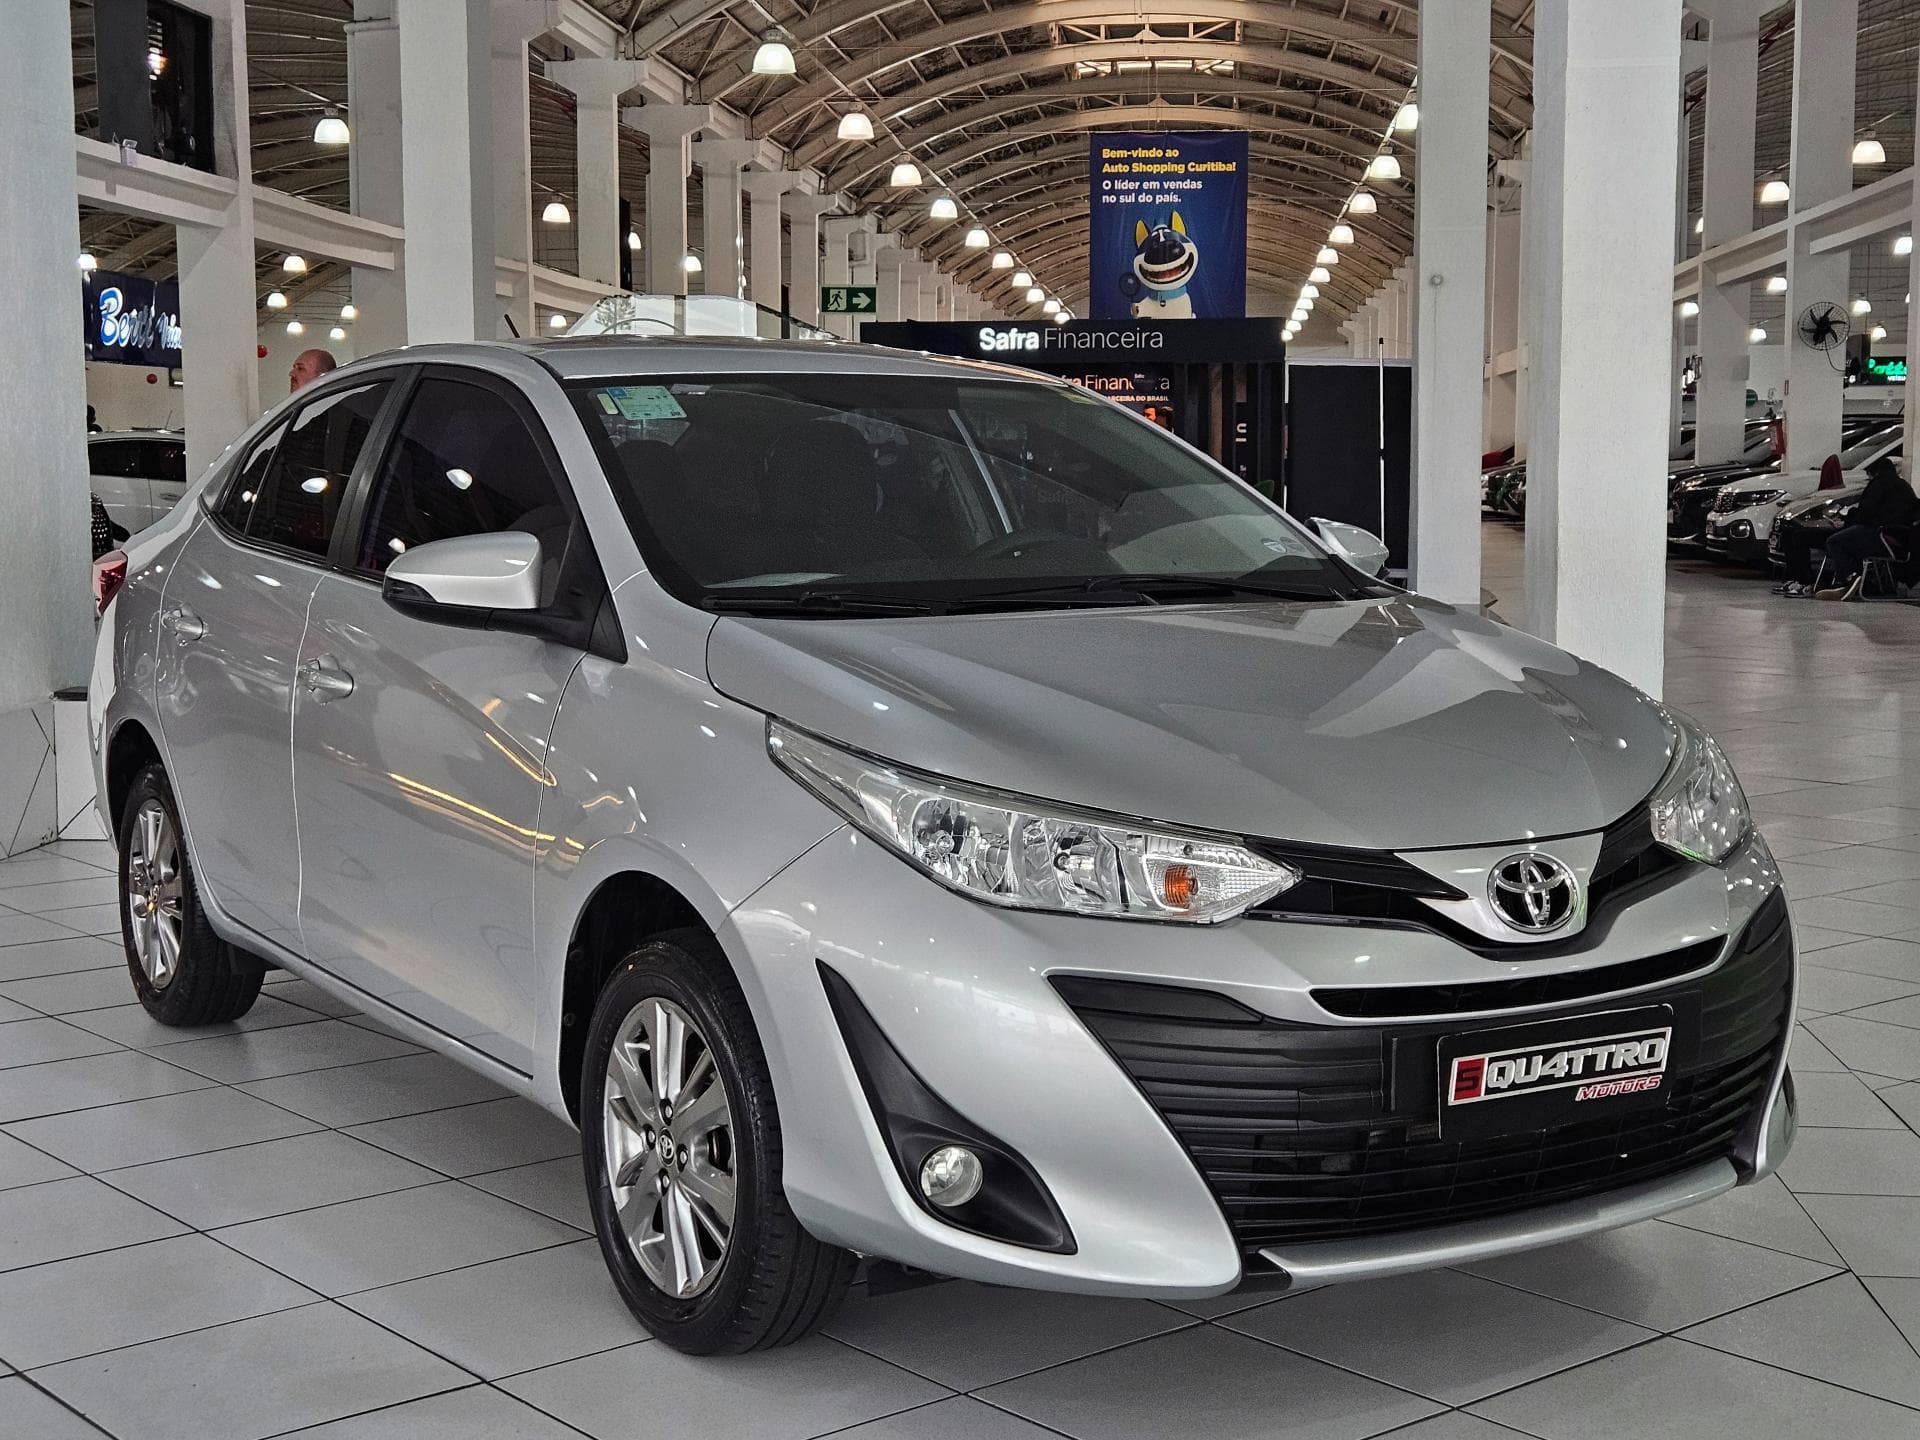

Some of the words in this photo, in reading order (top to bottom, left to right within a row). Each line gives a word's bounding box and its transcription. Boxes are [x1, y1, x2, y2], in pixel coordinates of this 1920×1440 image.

[1102, 148, 1163, 158] Bem-vindo
[1165, 149, 1179, 157] ao
[1102, 163, 1130, 173] Auto
[1132, 162, 1185, 174] Shopping
[1187, 161, 1236, 172] Curitiba!
[1102, 180, 1112, 190] O
[1114, 179, 1140, 189] líder
[1143, 181, 1160, 189] em
[1163, 179, 1203, 189] vendas
[1102, 194, 1117, 203] no
[1119, 193, 1135, 203] sul
[1138, 193, 1153, 202] do
[1155, 192, 1182, 204] país.
[979, 327, 1040, 350] Safra
[1044, 327, 1163, 349] Financeira
[1575, 1075, 1663, 1101] MOTORS
